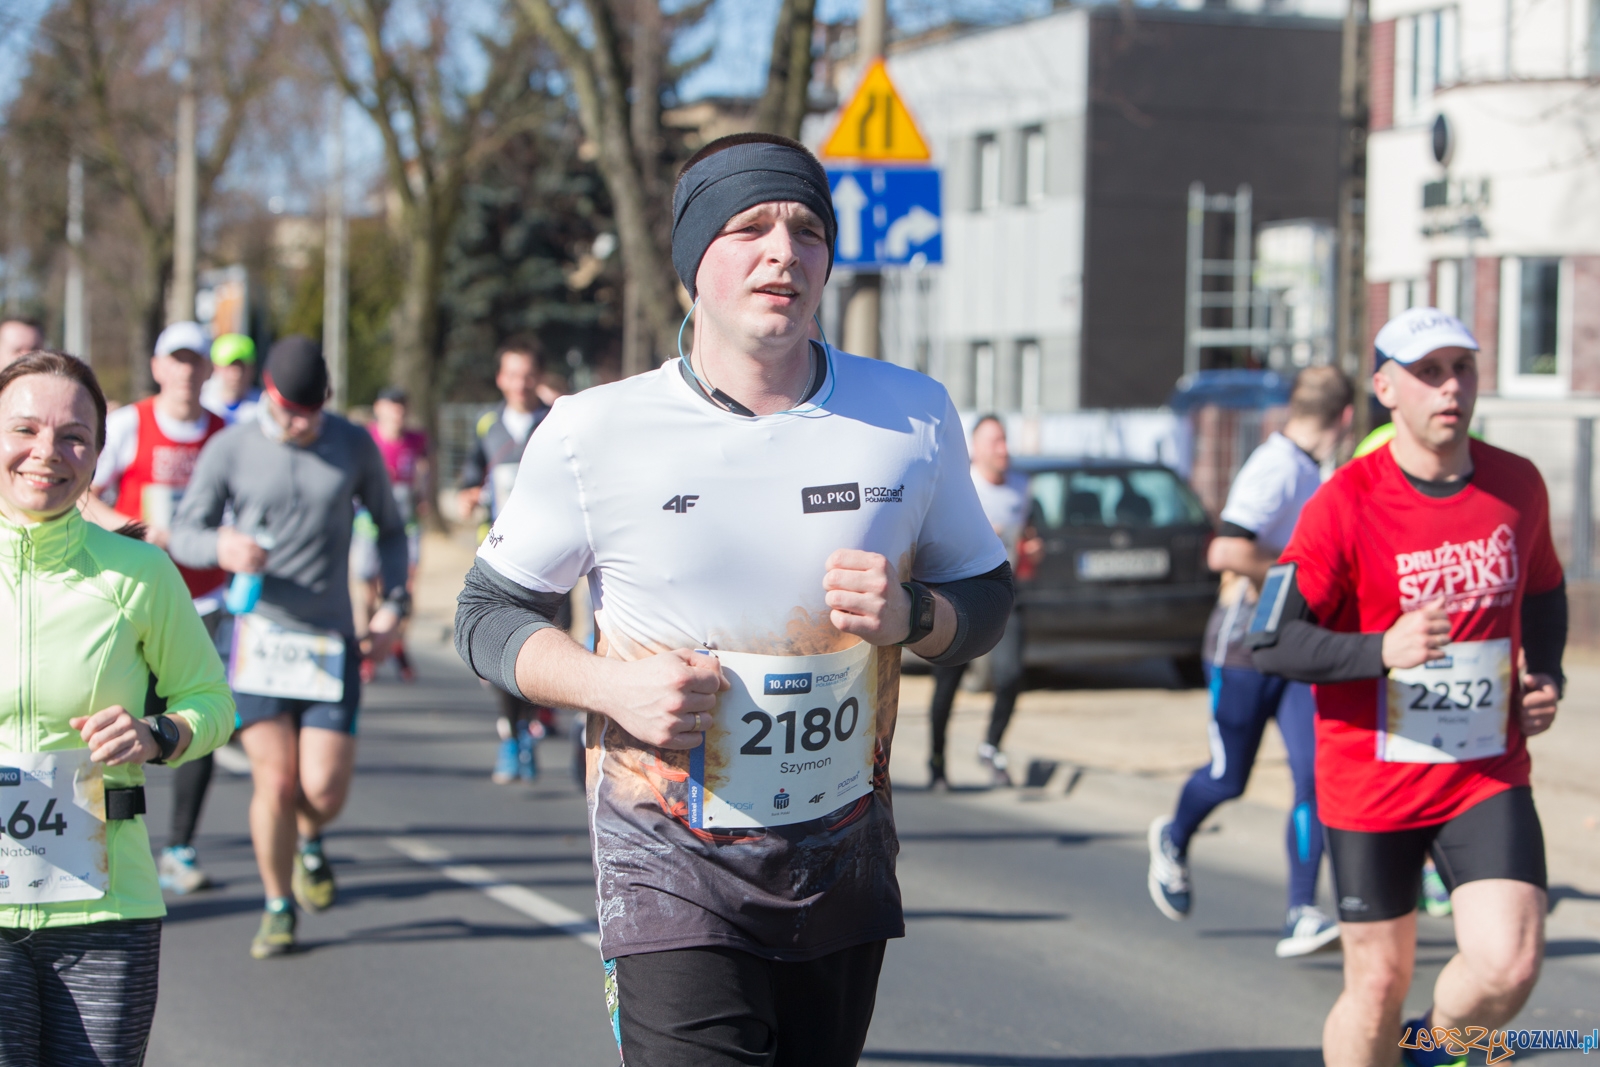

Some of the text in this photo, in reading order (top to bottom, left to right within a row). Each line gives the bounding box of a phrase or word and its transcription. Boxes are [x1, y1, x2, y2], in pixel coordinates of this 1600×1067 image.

[662, 494, 700, 514] 4F
[807, 490, 856, 506] 10. PKO
[1395, 539, 1501, 575] DRUŻYNA
[1399, 554, 1519, 605] SZPIKU
[769, 678, 808, 690] 10. PKO
[1409, 677, 1492, 710] 2232
[740, 696, 859, 755] 2180
[780, 756, 832, 774] Szymon
[808, 792, 826, 804] 4F
[0, 845, 46, 858] Natalia
[28, 878, 44, 889] 4F
